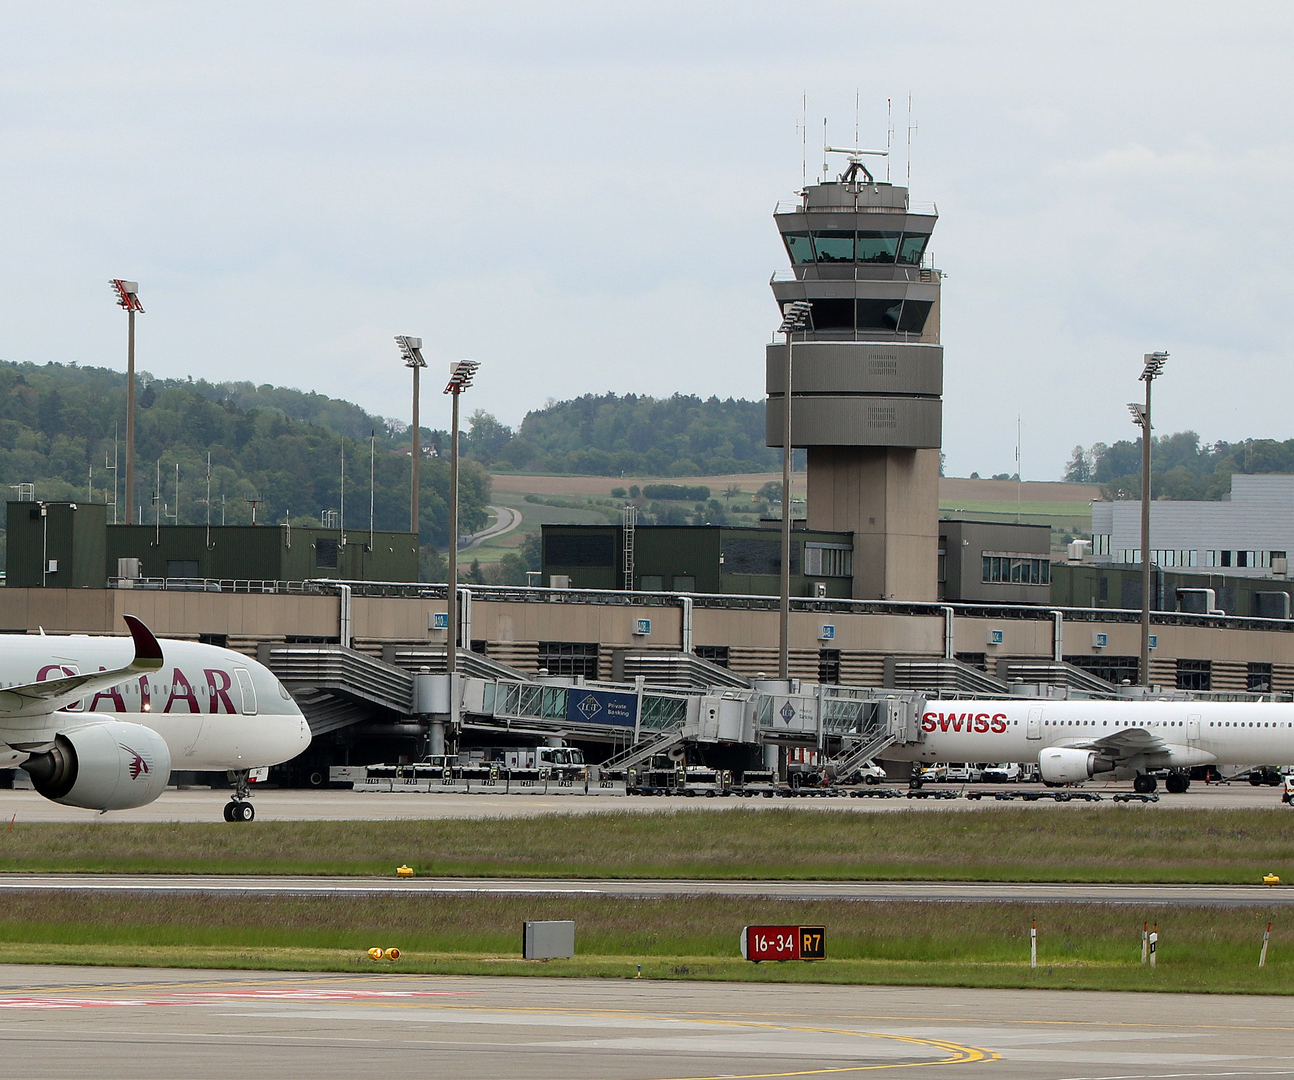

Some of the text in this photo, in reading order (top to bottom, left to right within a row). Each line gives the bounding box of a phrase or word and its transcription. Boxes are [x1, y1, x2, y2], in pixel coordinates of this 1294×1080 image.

[581, 703, 599, 711] LGT
[922, 712, 1007, 733] SWISS
[755, 934, 793, 952] 16-34
[804, 934, 821, 952] R7
